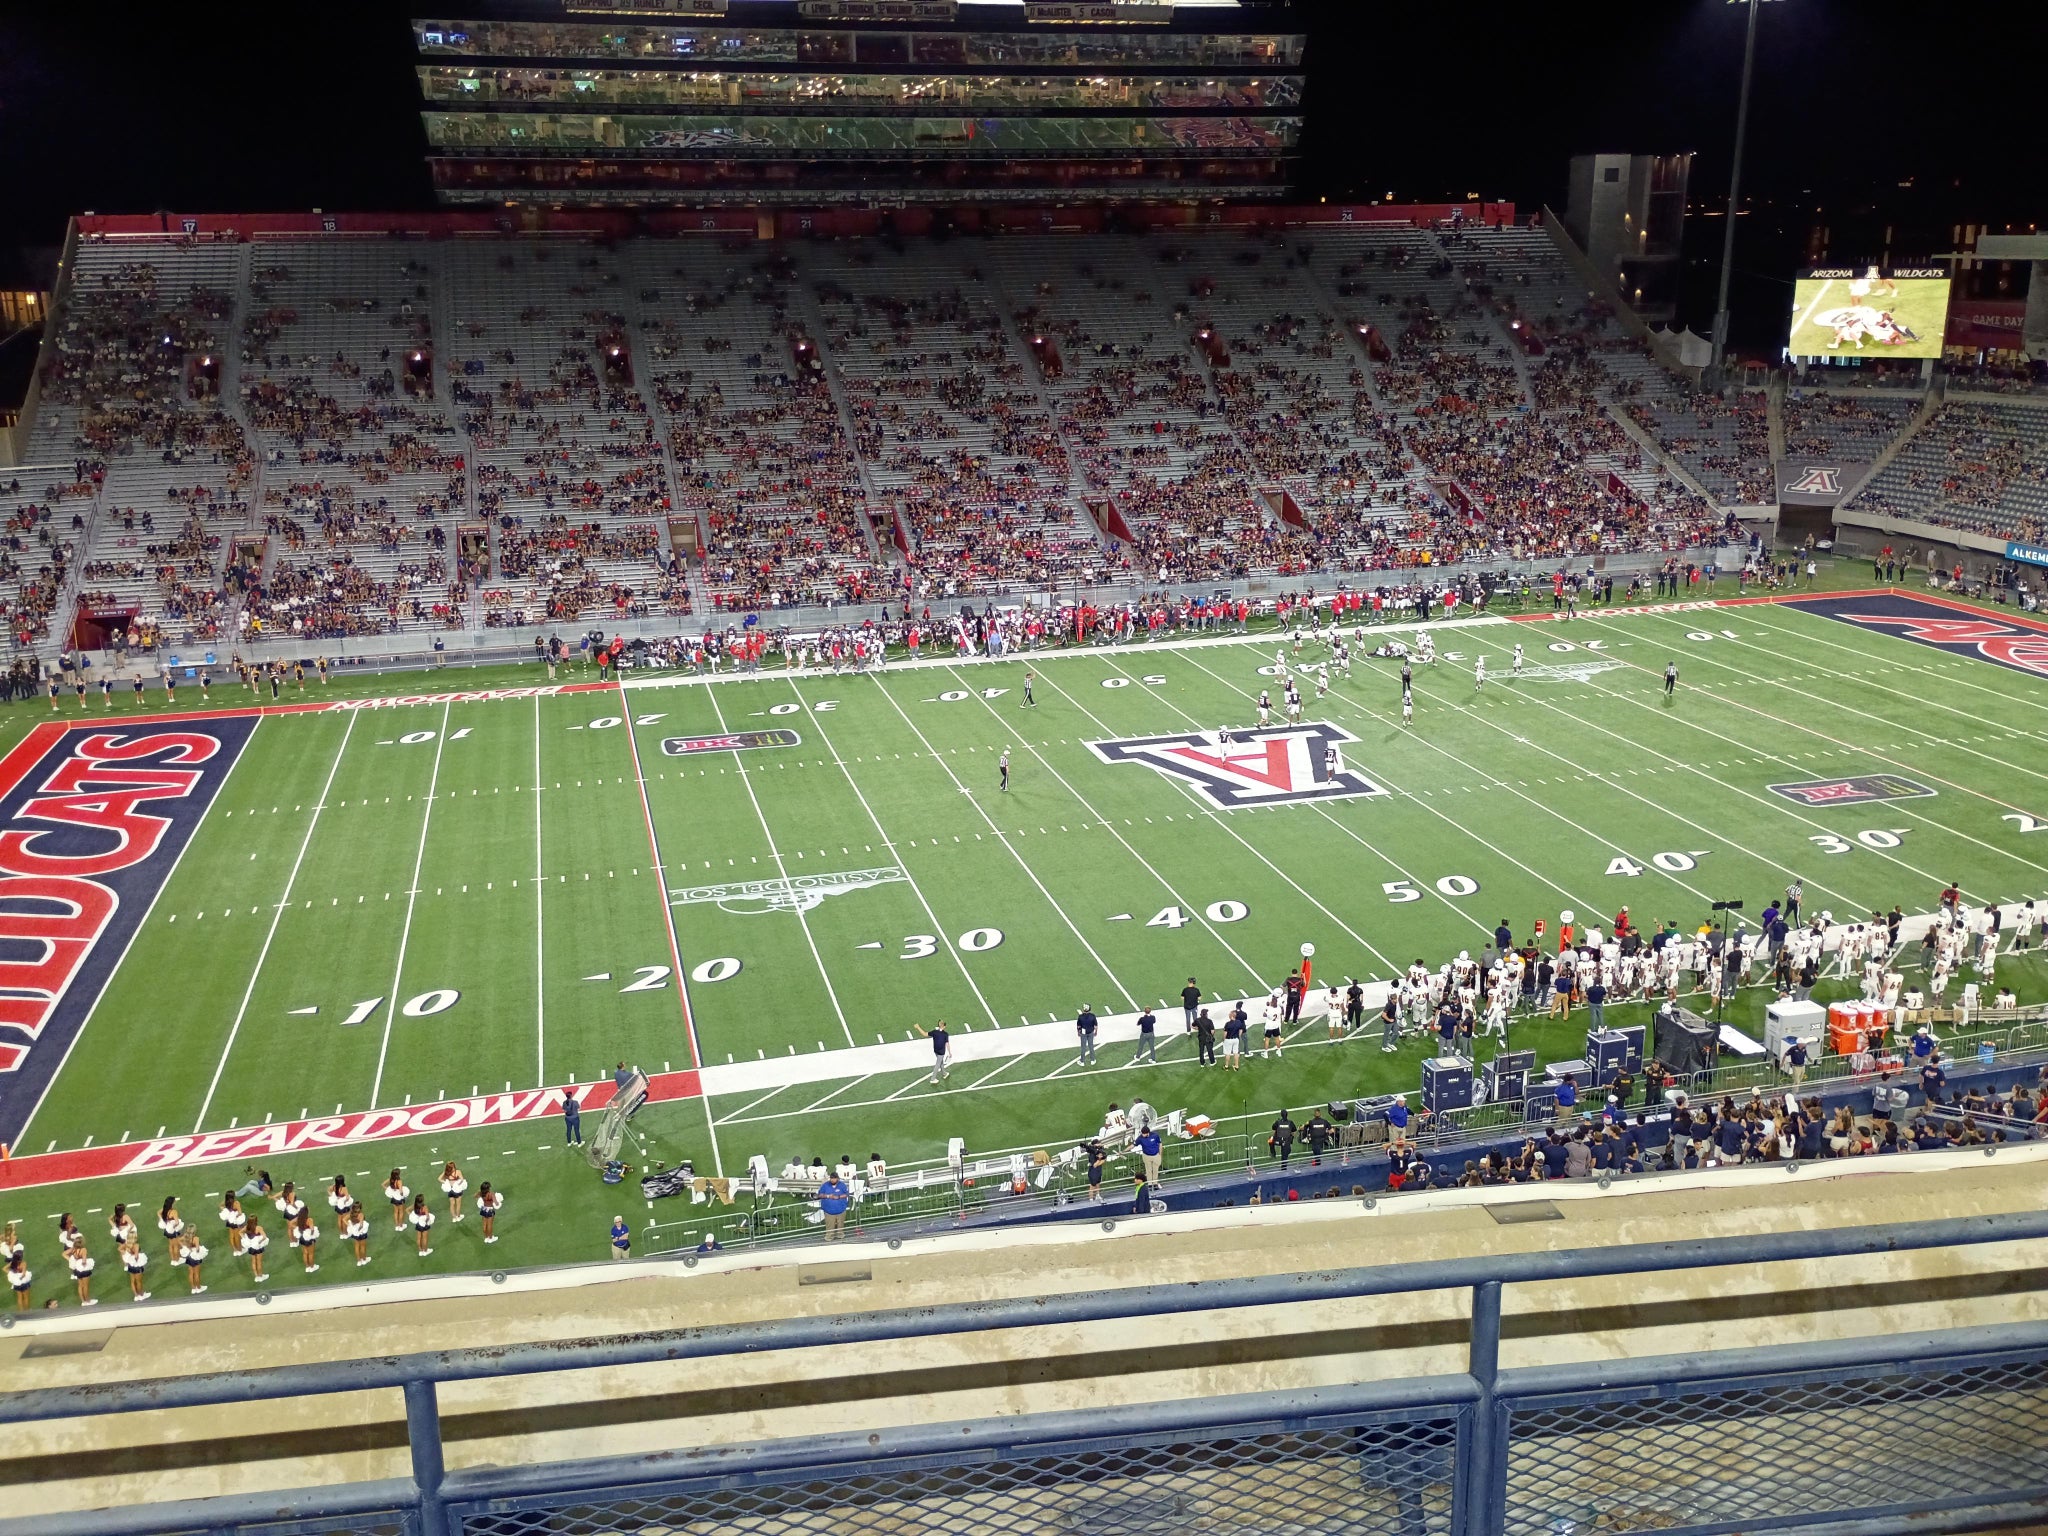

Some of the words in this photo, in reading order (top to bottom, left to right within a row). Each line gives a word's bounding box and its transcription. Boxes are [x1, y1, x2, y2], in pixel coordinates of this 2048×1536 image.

[1209, 214, 1221, 222] 23
[1342, 213, 1353, 221] 24
[183, 222, 195, 232] 17
[324, 222, 336, 231] 18
[801, 220, 812, 229] 21
[1810, 270, 1853, 278] ARIZONA
[1893, 269, 1944, 277] WILDCATS
[1972, 315, 2001, 326] GAME
[2004, 316, 2024, 326] DAY
[795, 868, 900, 888] CASINO
[736, 881, 786, 896] DEL
[672, 887, 727, 900] SOL
[1457, 966, 1468, 975] 90
[1114, 1114, 1126, 1126] 45
